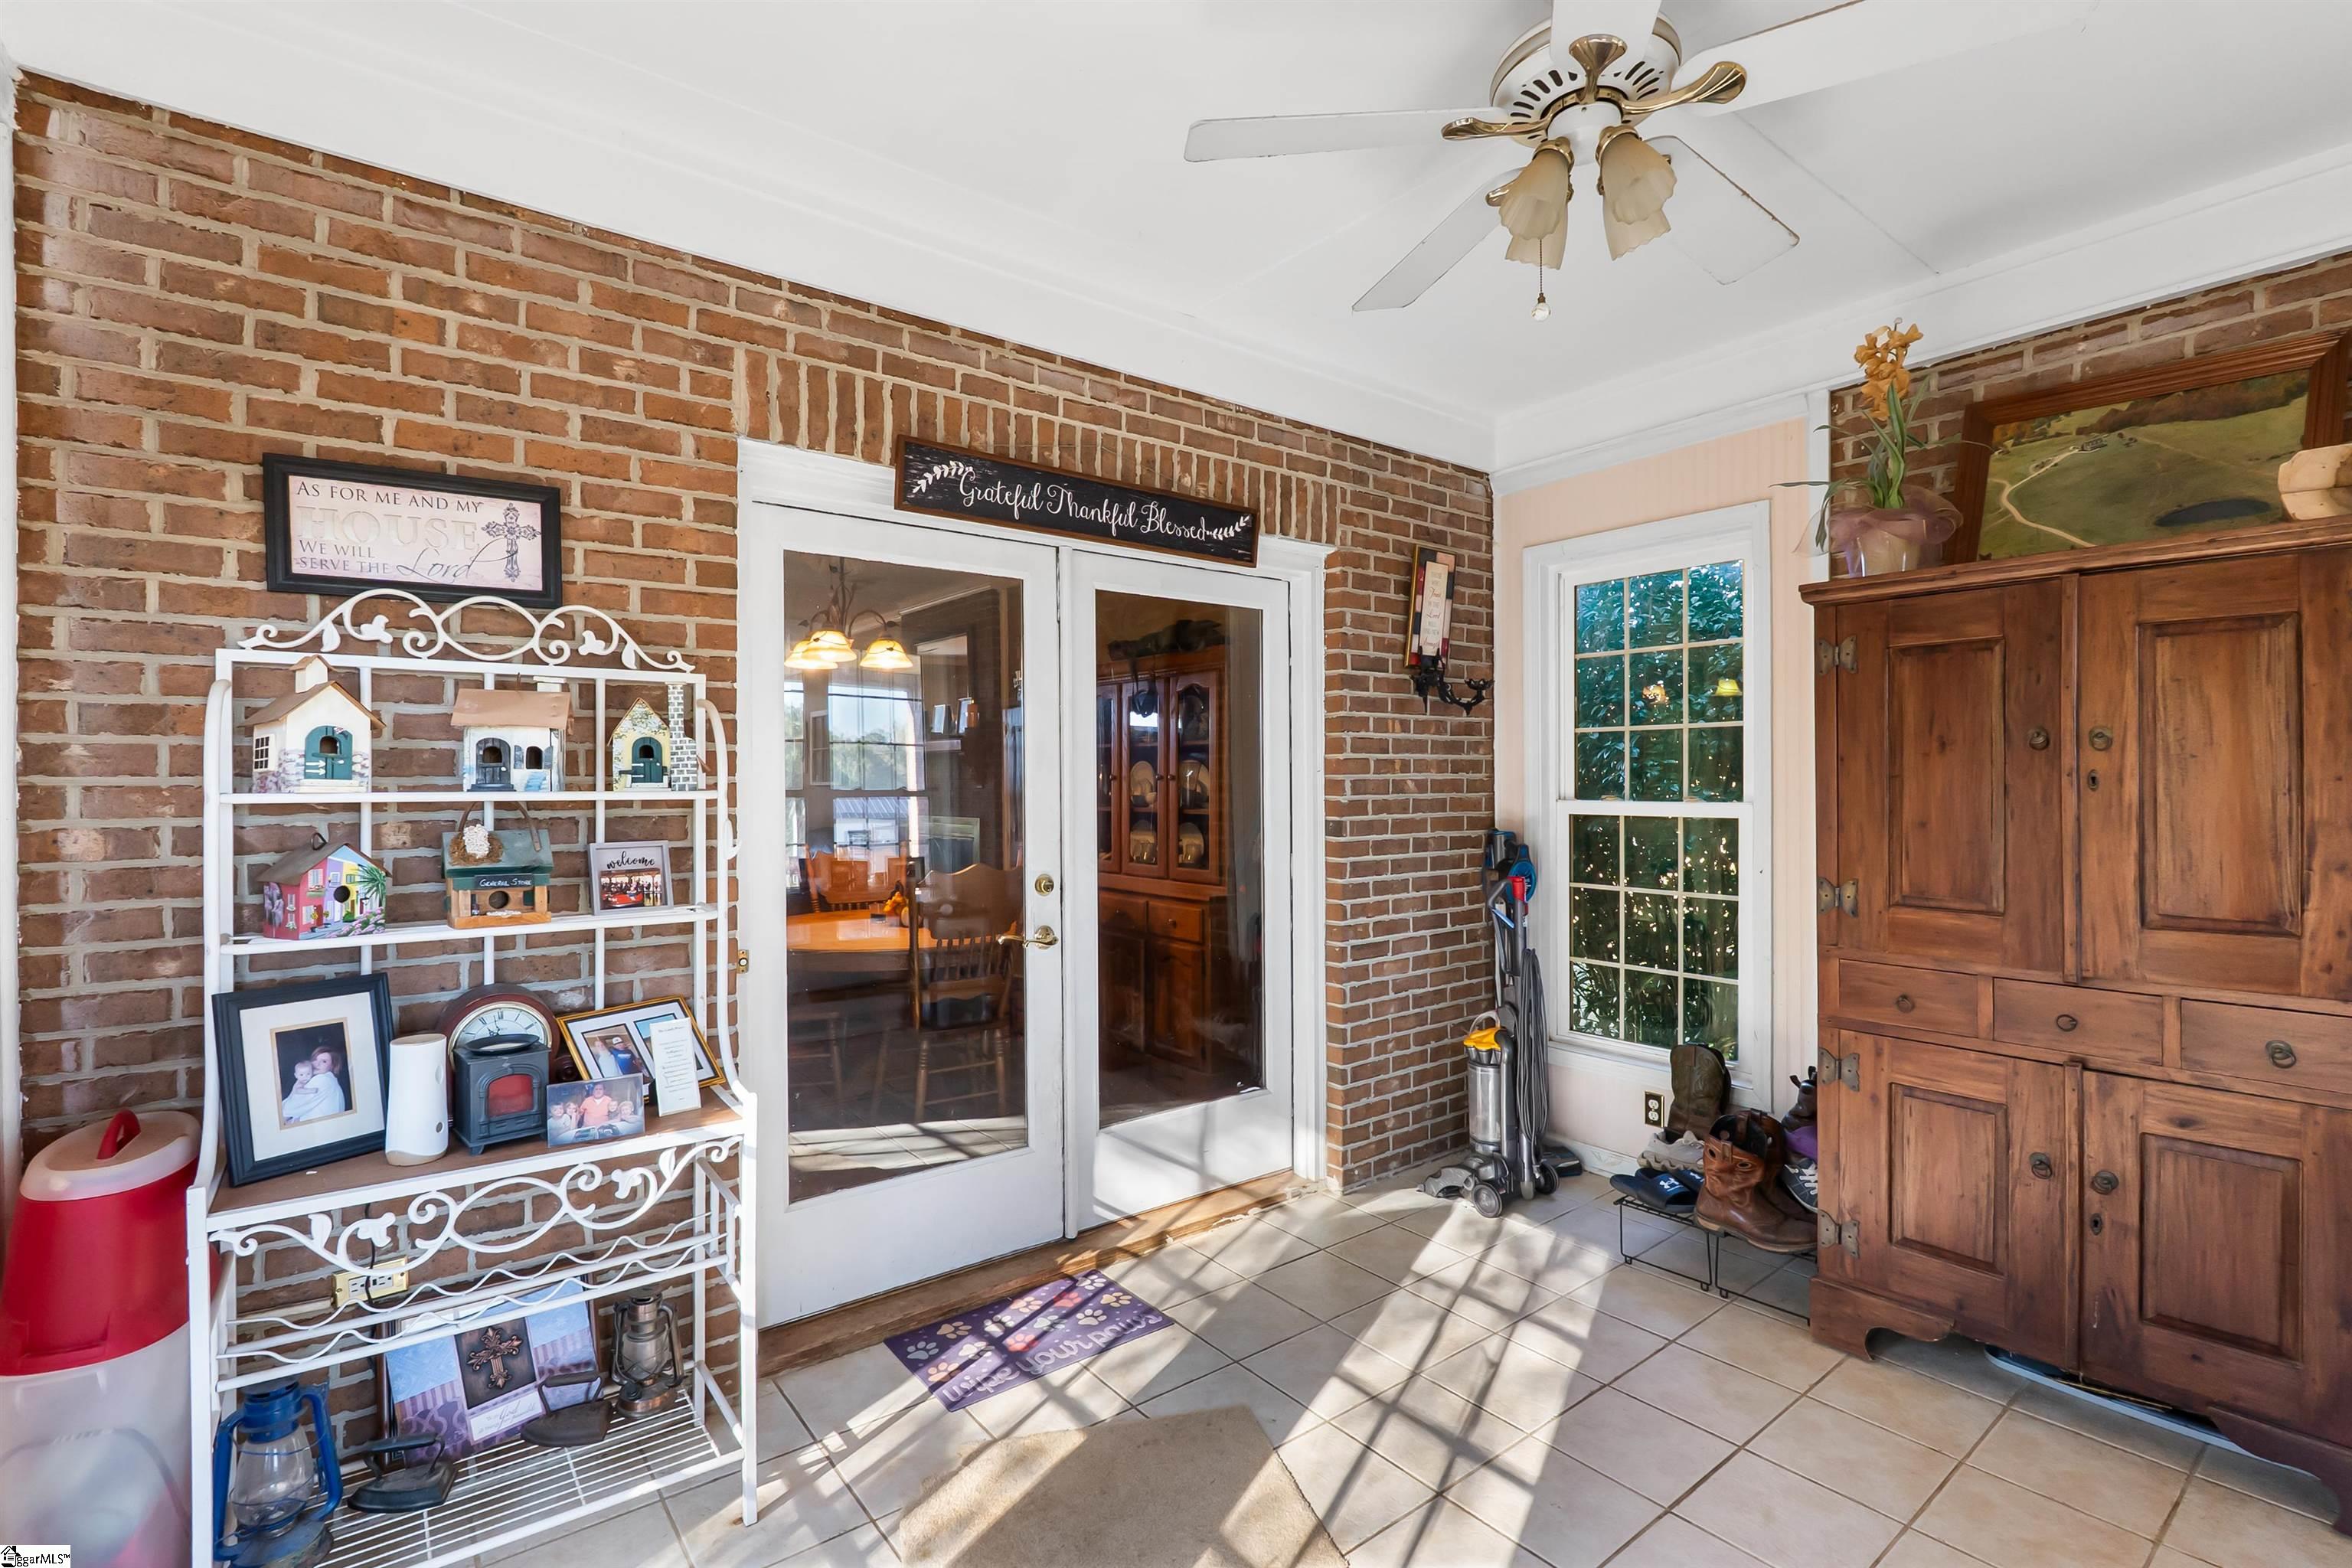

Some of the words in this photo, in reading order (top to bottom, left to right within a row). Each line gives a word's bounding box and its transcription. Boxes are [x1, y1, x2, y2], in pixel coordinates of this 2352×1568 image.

[331, 486, 368, 502] FOR
[375, 492, 403, 505] ME
[409, 495, 449, 510] AND
[456, 501, 485, 514] MY
[959, 470, 1044, 520] Grateful
[1047, 483, 1138, 536] Thankful
[1140, 501, 1205, 542] Blessed
[299, 557, 350, 571] SERVE
[358, 561, 393, 574] THE
[397, 541, 488, 583] Lord
[334, 544, 375, 558] WILL
[606, 851, 656, 869] welcome
[1015, 1338, 1093, 1377] your
[1087, 1314, 1163, 1351] paws
